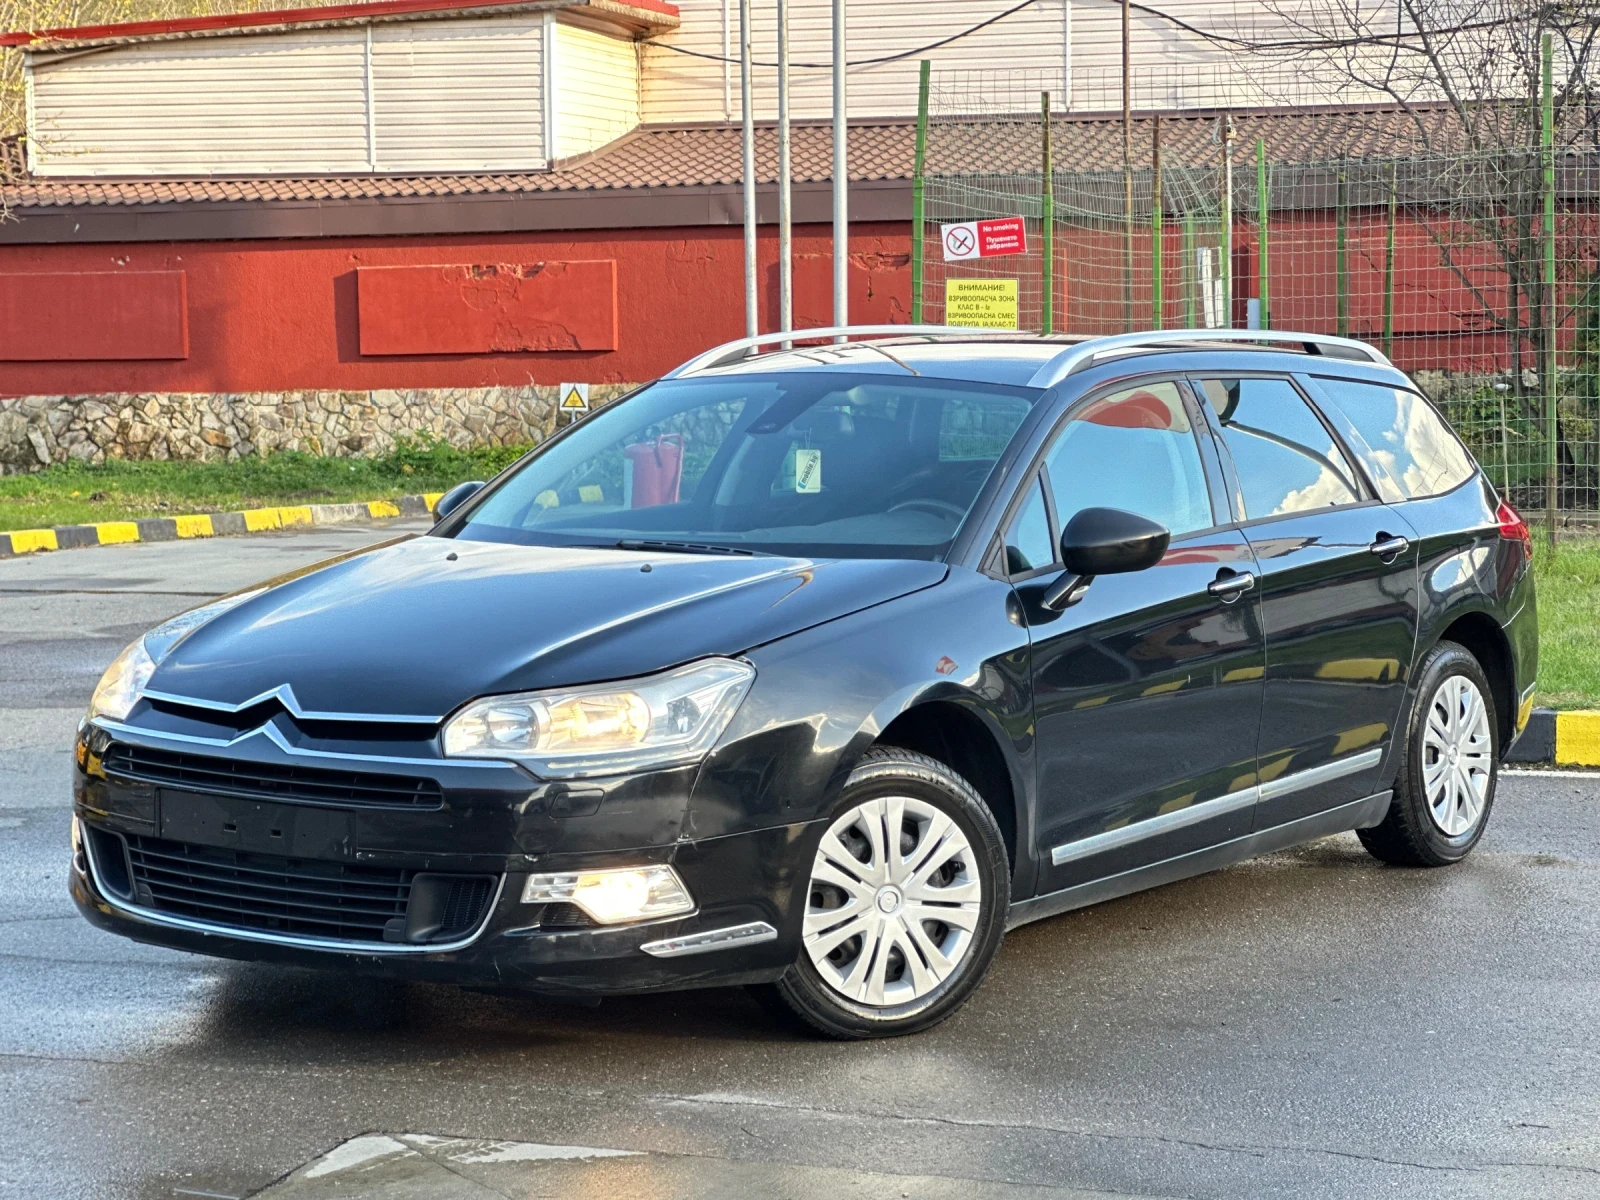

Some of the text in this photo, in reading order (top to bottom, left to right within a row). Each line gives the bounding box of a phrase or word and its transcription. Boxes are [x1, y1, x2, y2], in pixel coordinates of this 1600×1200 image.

[993, 223, 1019, 231] smoking
[986, 235, 1018, 243] Пушенето
[986, 242, 1019, 250] забранено
